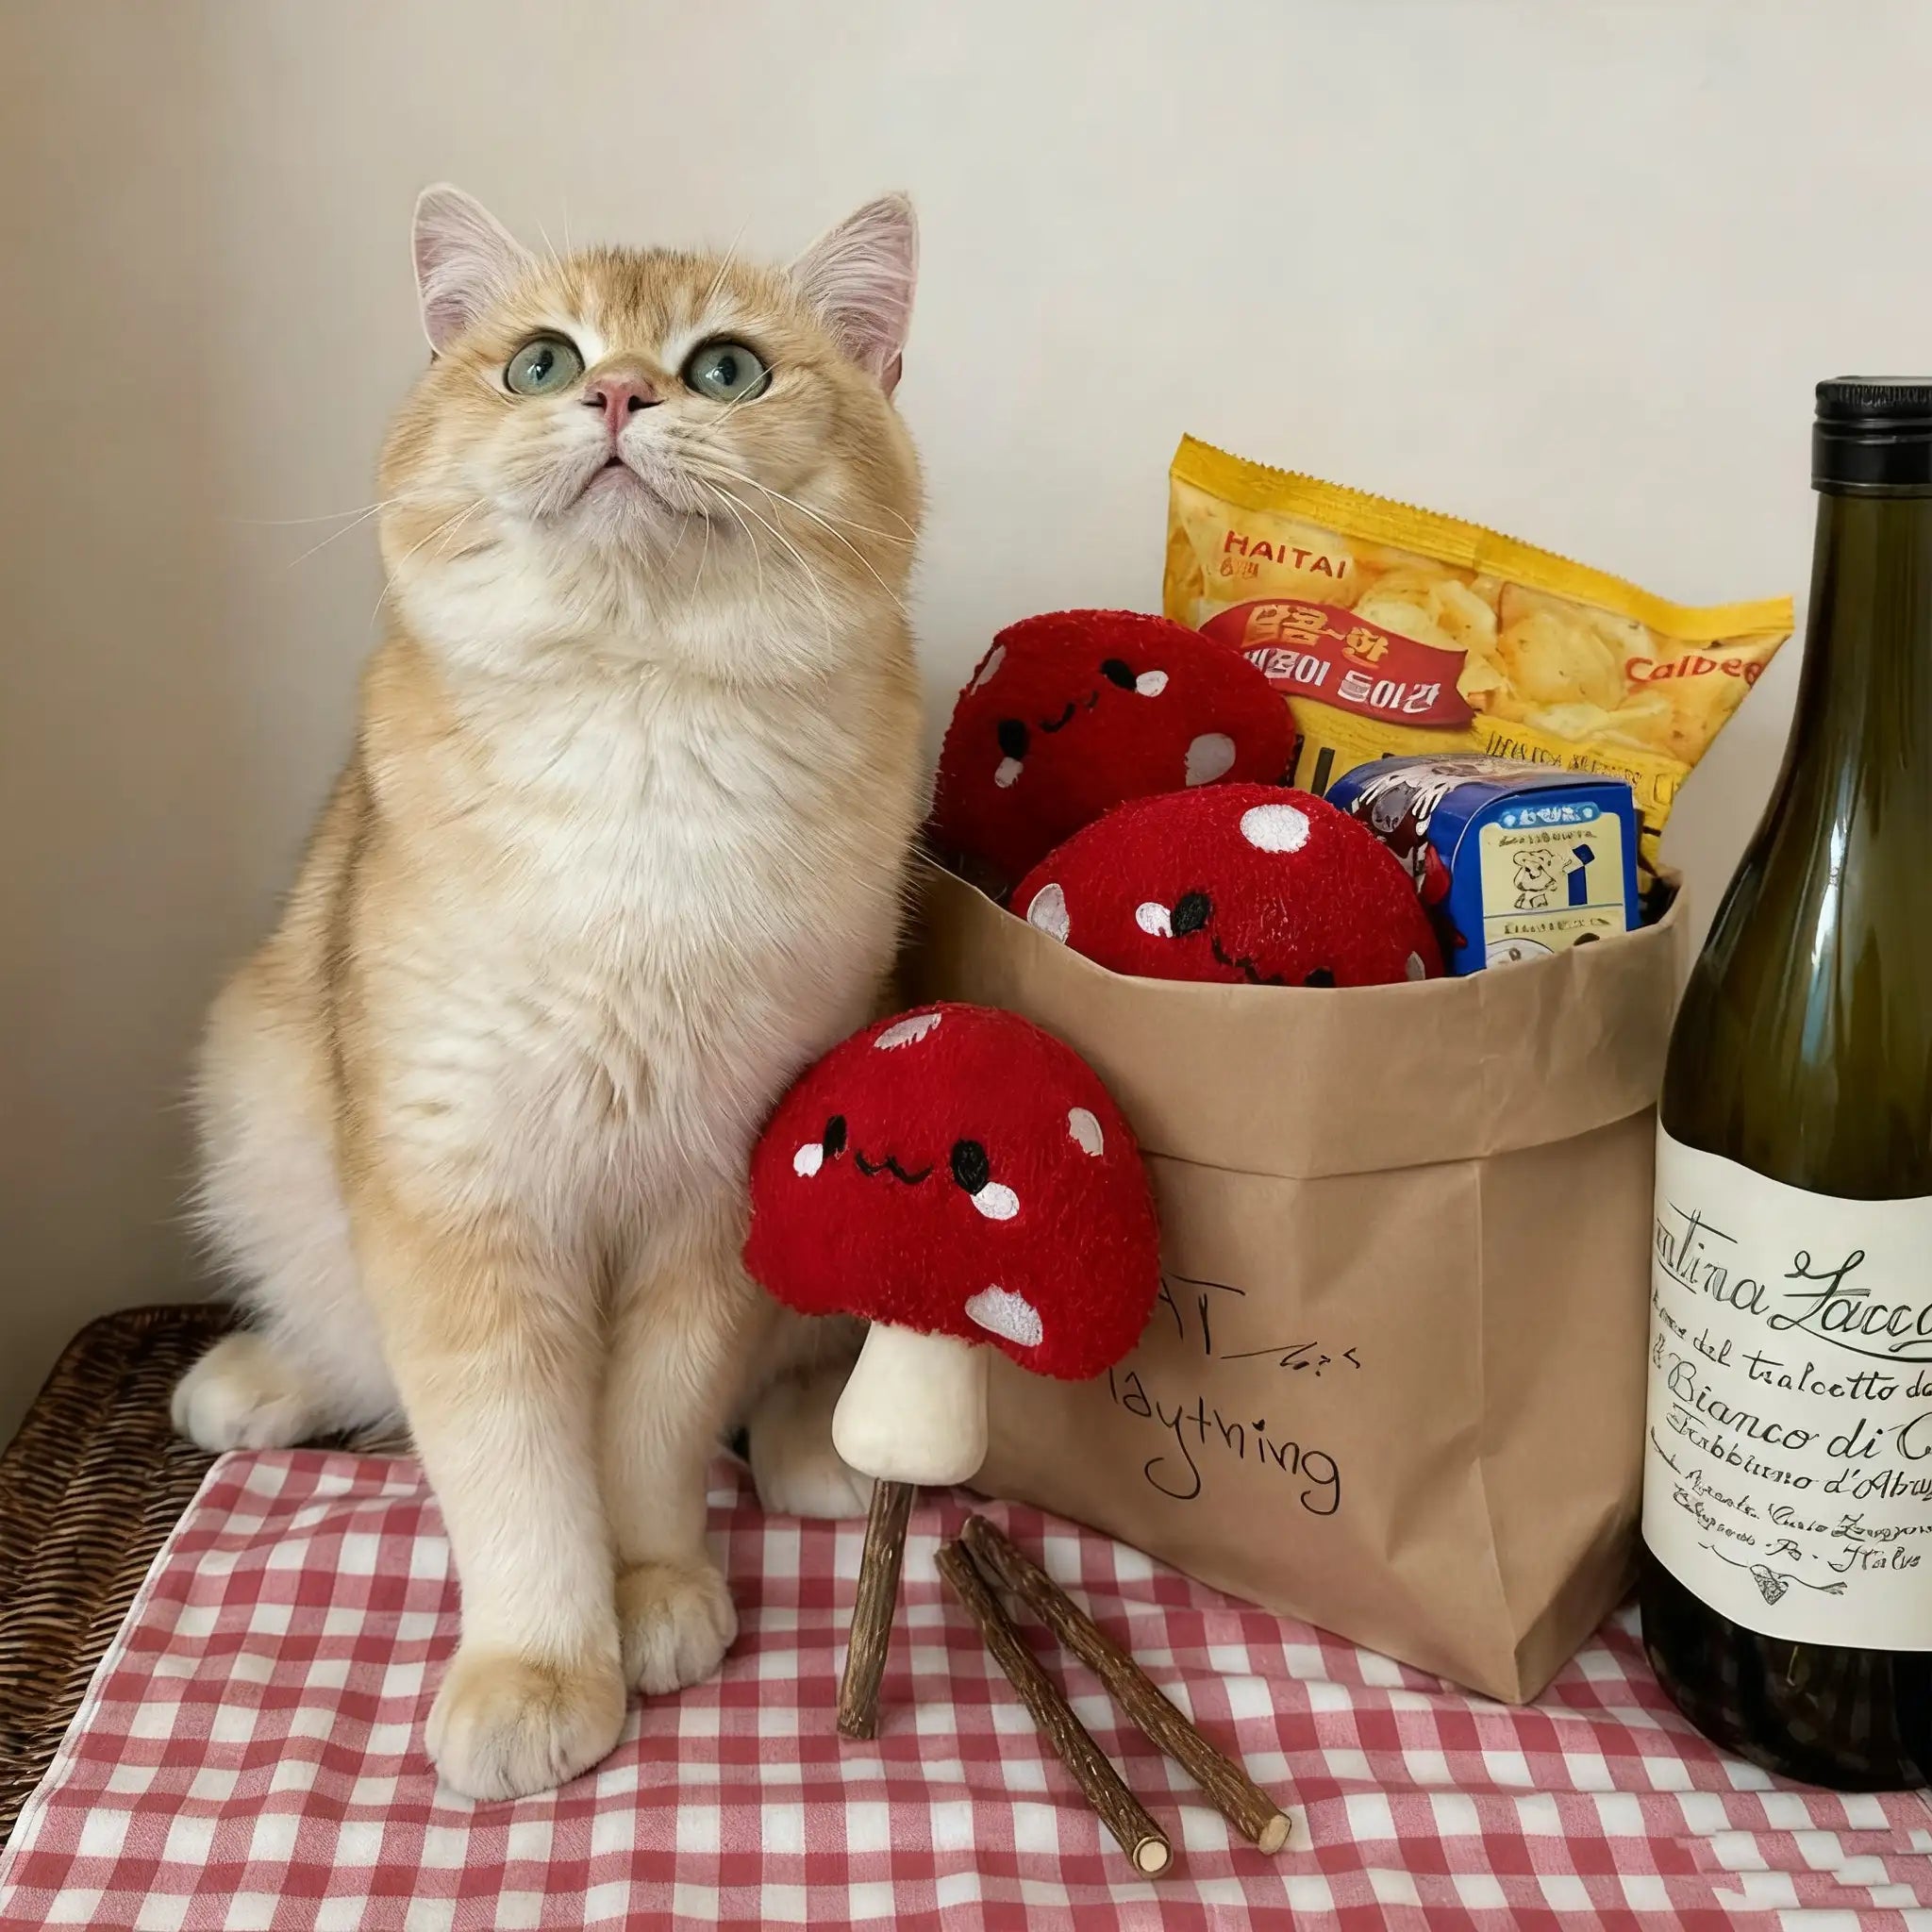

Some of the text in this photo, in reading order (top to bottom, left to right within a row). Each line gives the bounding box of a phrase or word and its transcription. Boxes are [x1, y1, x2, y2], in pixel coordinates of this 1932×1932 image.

[1224, 529, 1346, 578] HAITAI
[1668, 1356, 1820, 1449] Bianco
[1826, 1418, 1880, 1458] di
